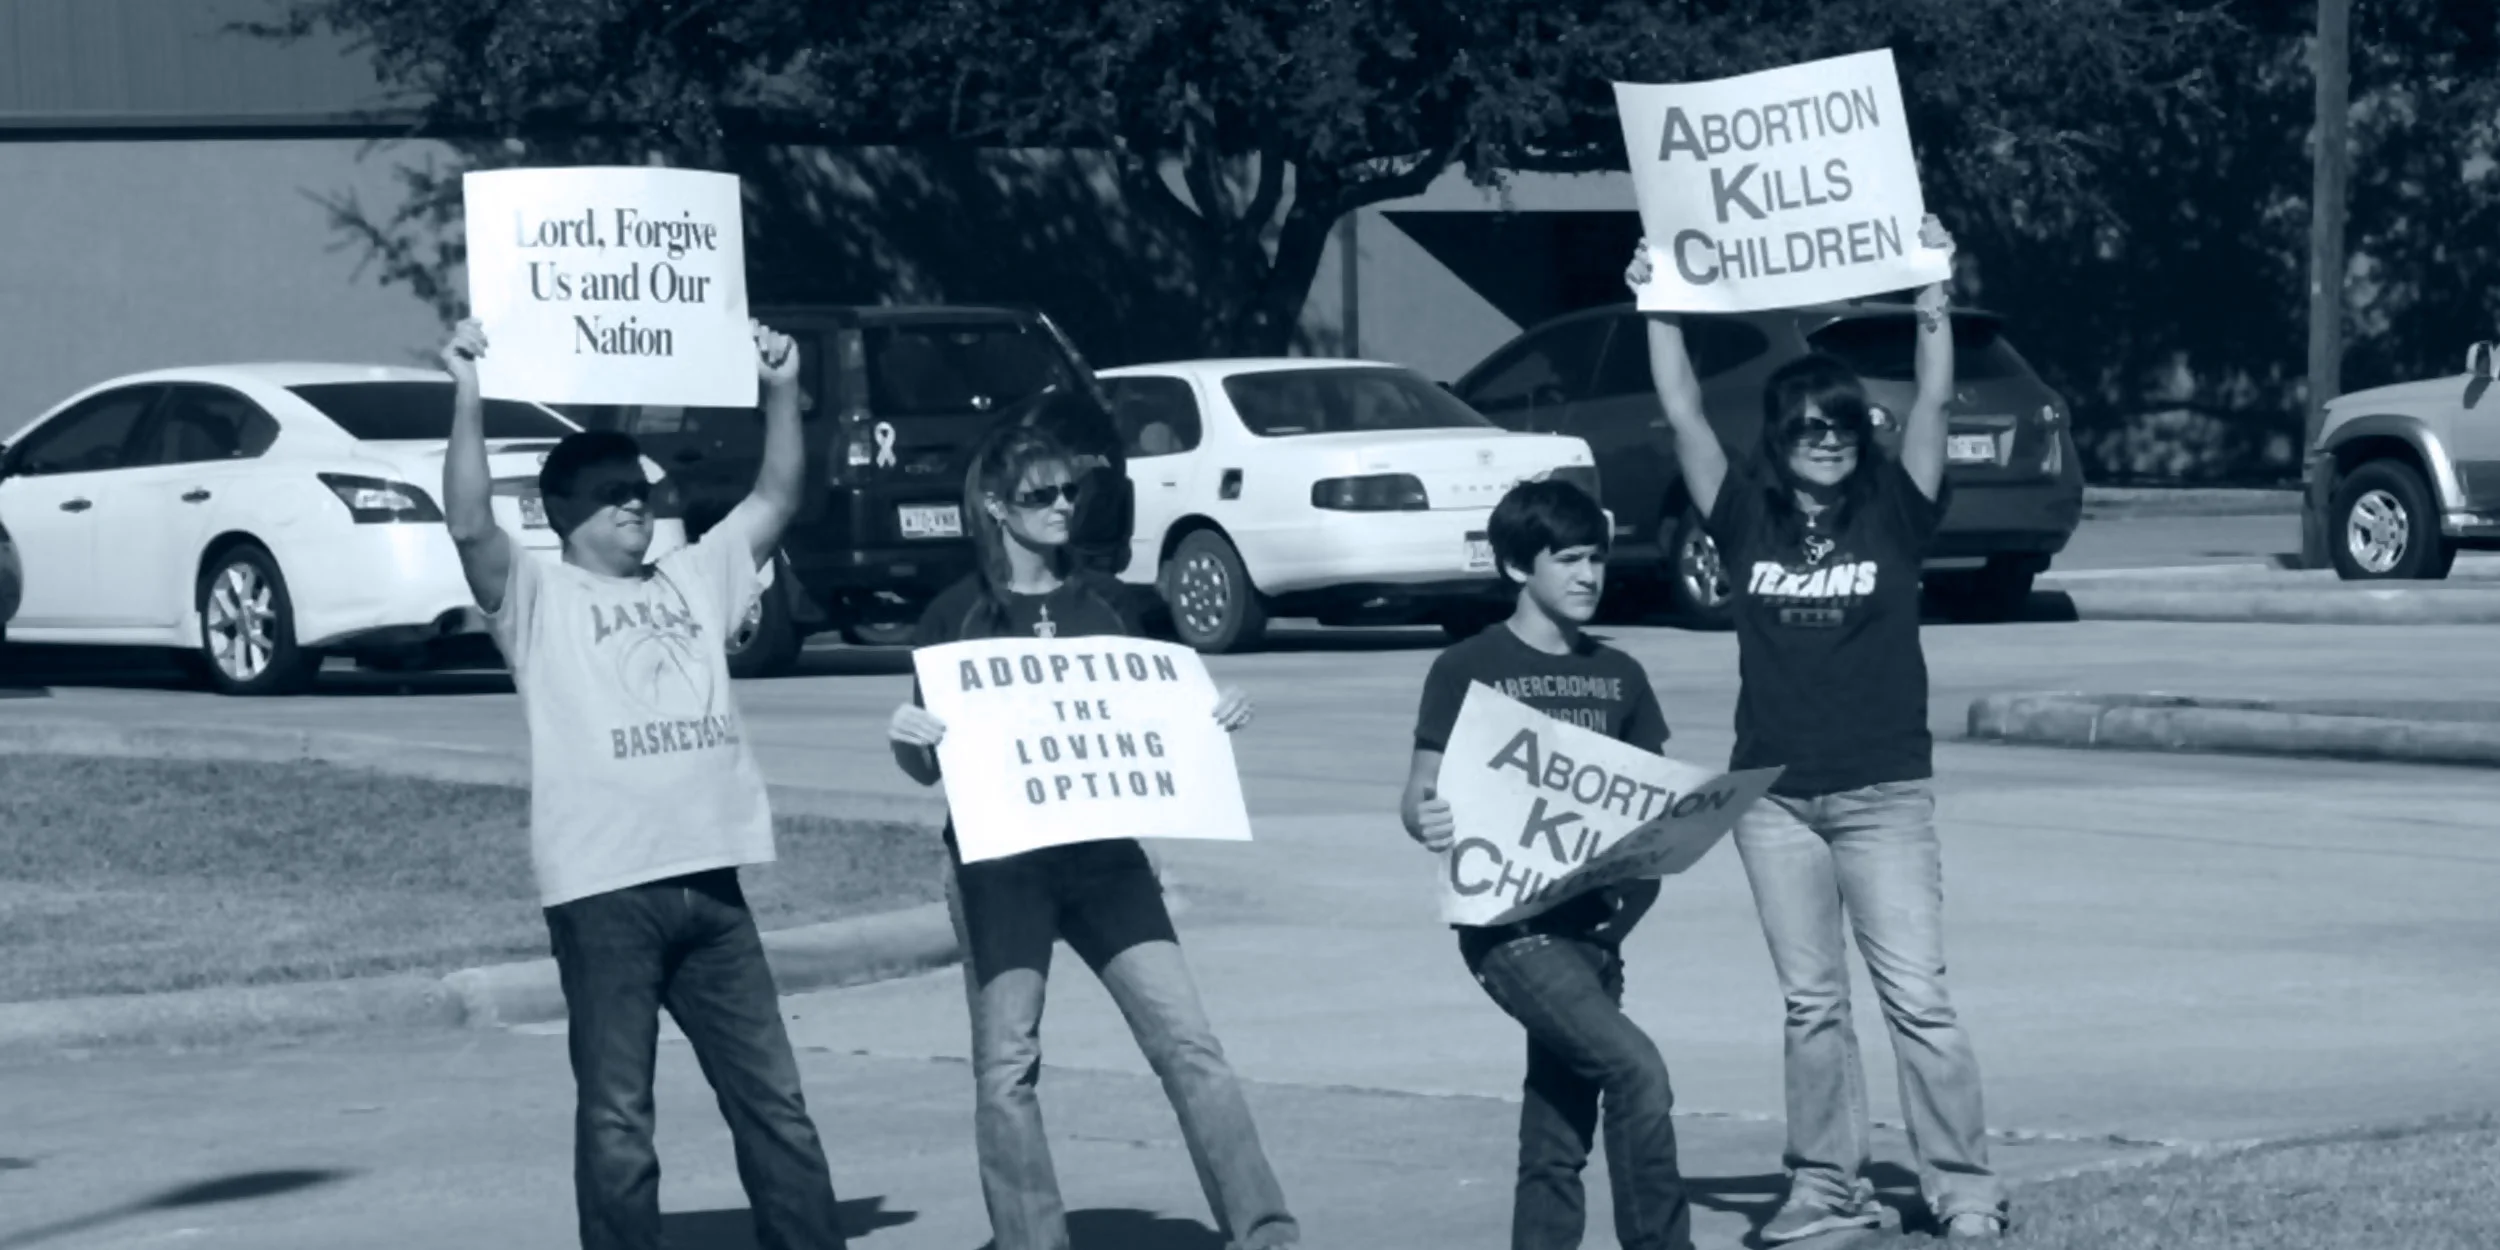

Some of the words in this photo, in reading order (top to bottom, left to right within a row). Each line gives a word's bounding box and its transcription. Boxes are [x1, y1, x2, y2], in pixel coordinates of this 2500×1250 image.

[1658, 85, 1880, 161] ABORTION
[1710, 158, 1853, 223] KILLS
[514, 208, 606, 256] Lord,
[615, 208, 717, 260] Forgive
[1673, 215, 1903, 286] CHILDREN
[528, 262, 572, 301] Us
[581, 262, 639, 301] and
[650, 261, 710, 303] Our
[573, 315, 673, 356] Nation
[1748, 561, 1877, 597] TEXANS
[959, 652, 1178, 691] ADOPTION
[1053, 700, 1112, 721] THE
[1016, 731, 1164, 764] LOVING
[1025, 770, 1177, 804] OPTION
